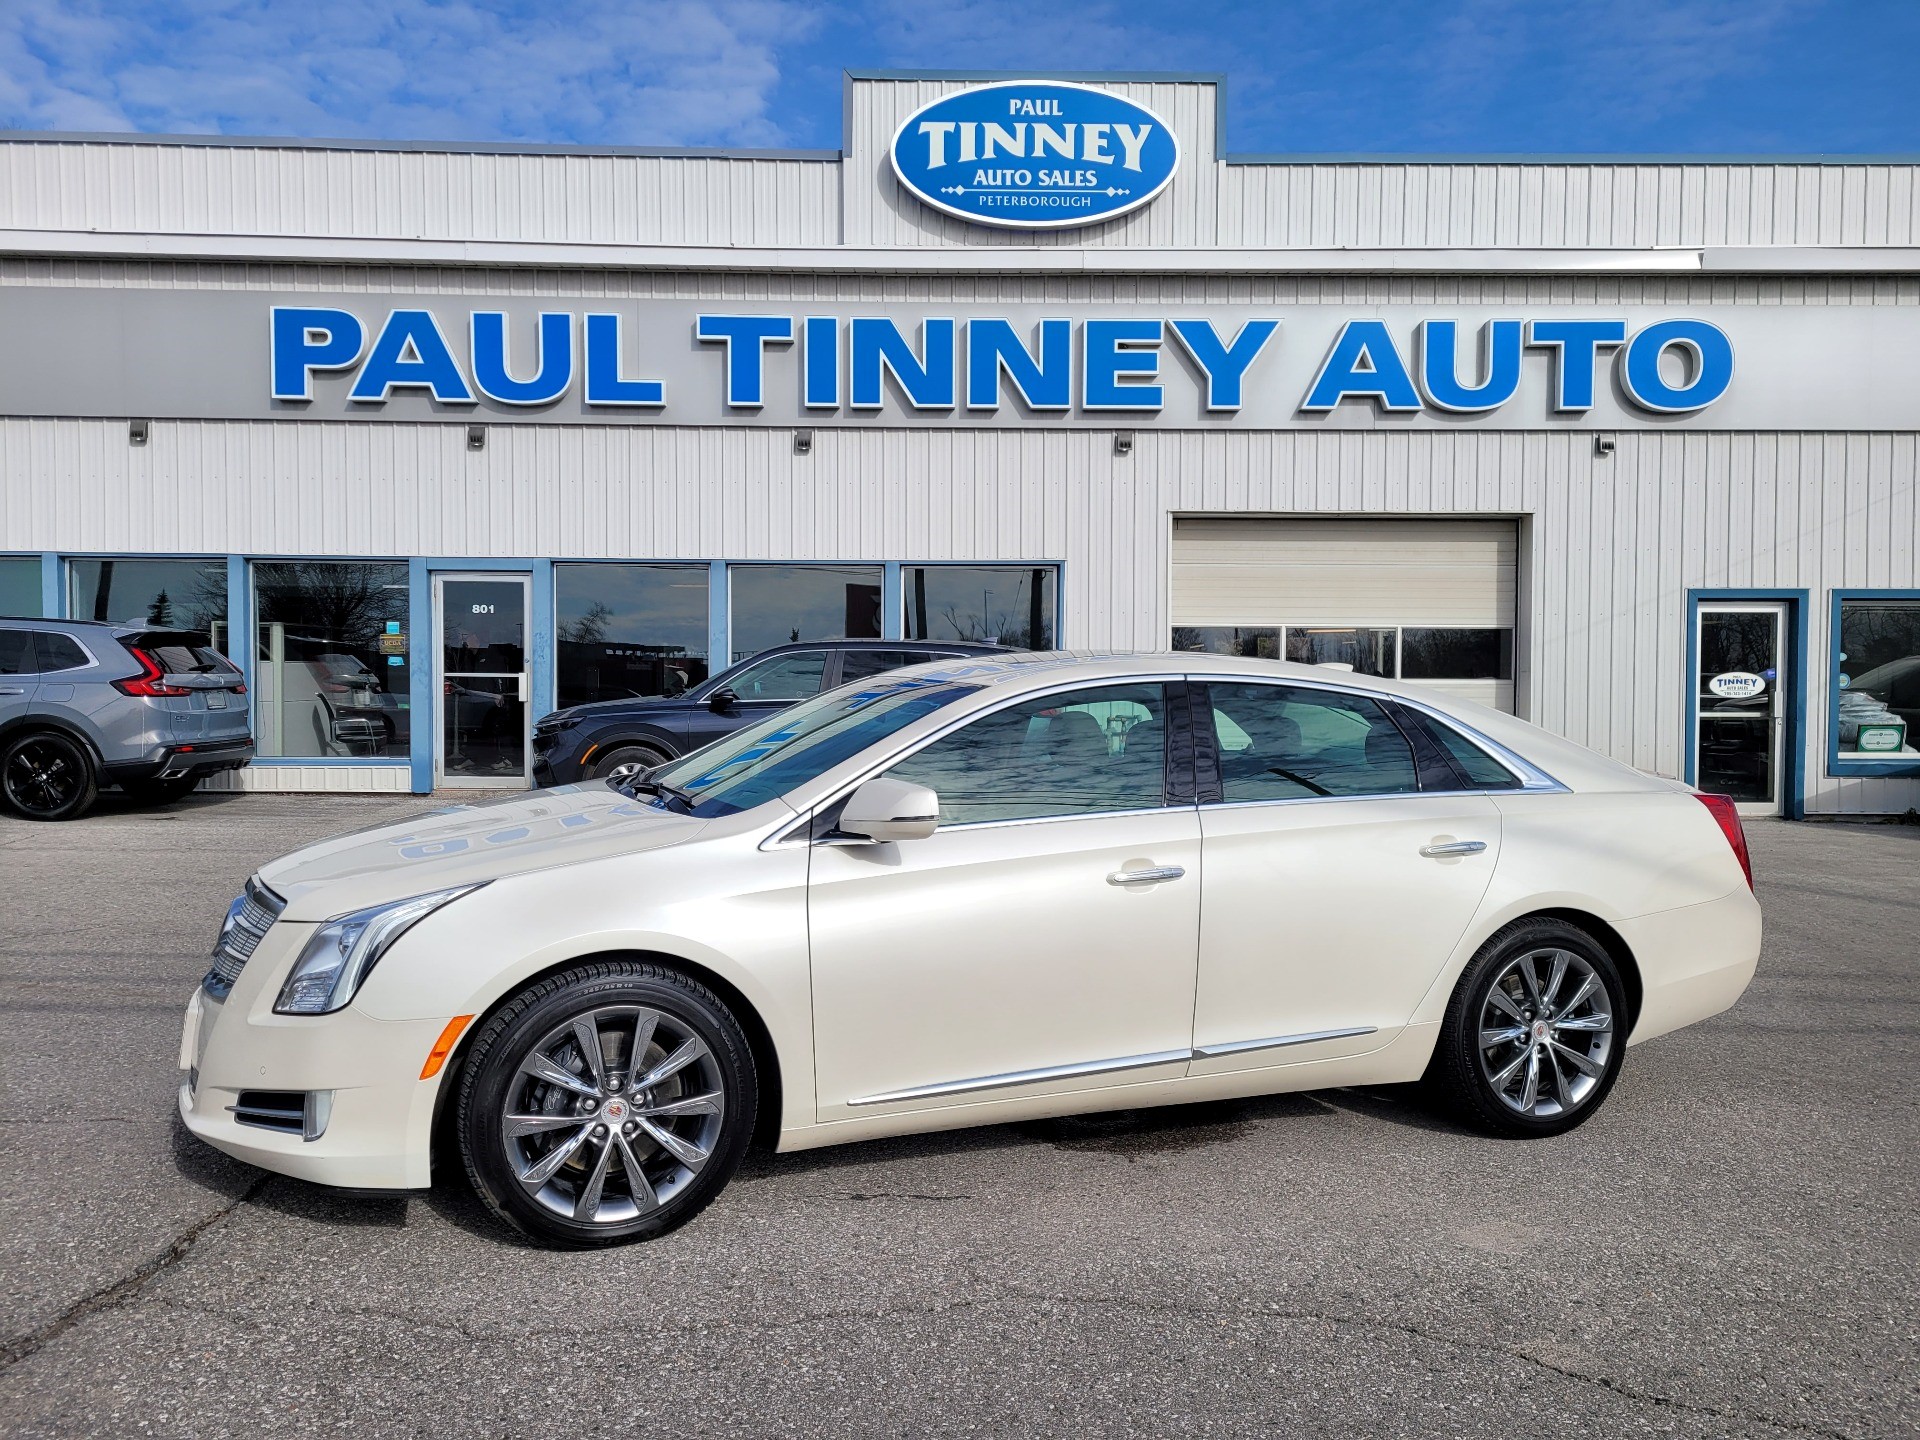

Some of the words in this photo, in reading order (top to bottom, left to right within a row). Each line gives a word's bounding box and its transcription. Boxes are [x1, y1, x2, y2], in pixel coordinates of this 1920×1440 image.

[1009, 99, 1063, 116] PAUL
[918, 121, 1152, 172] TINNEY
[973, 169, 1032, 186] AUTO
[1038, 170, 1098, 187] SALES
[979, 195, 1091, 207] PETERBOROUGH
[270, 306, 667, 407] PAUL
[696, 314, 1281, 411] TINNEY
[1300, 318, 1735, 413] AUTO
[472, 604, 495, 614] 801
[1717, 678, 1758, 688] TINNEY
